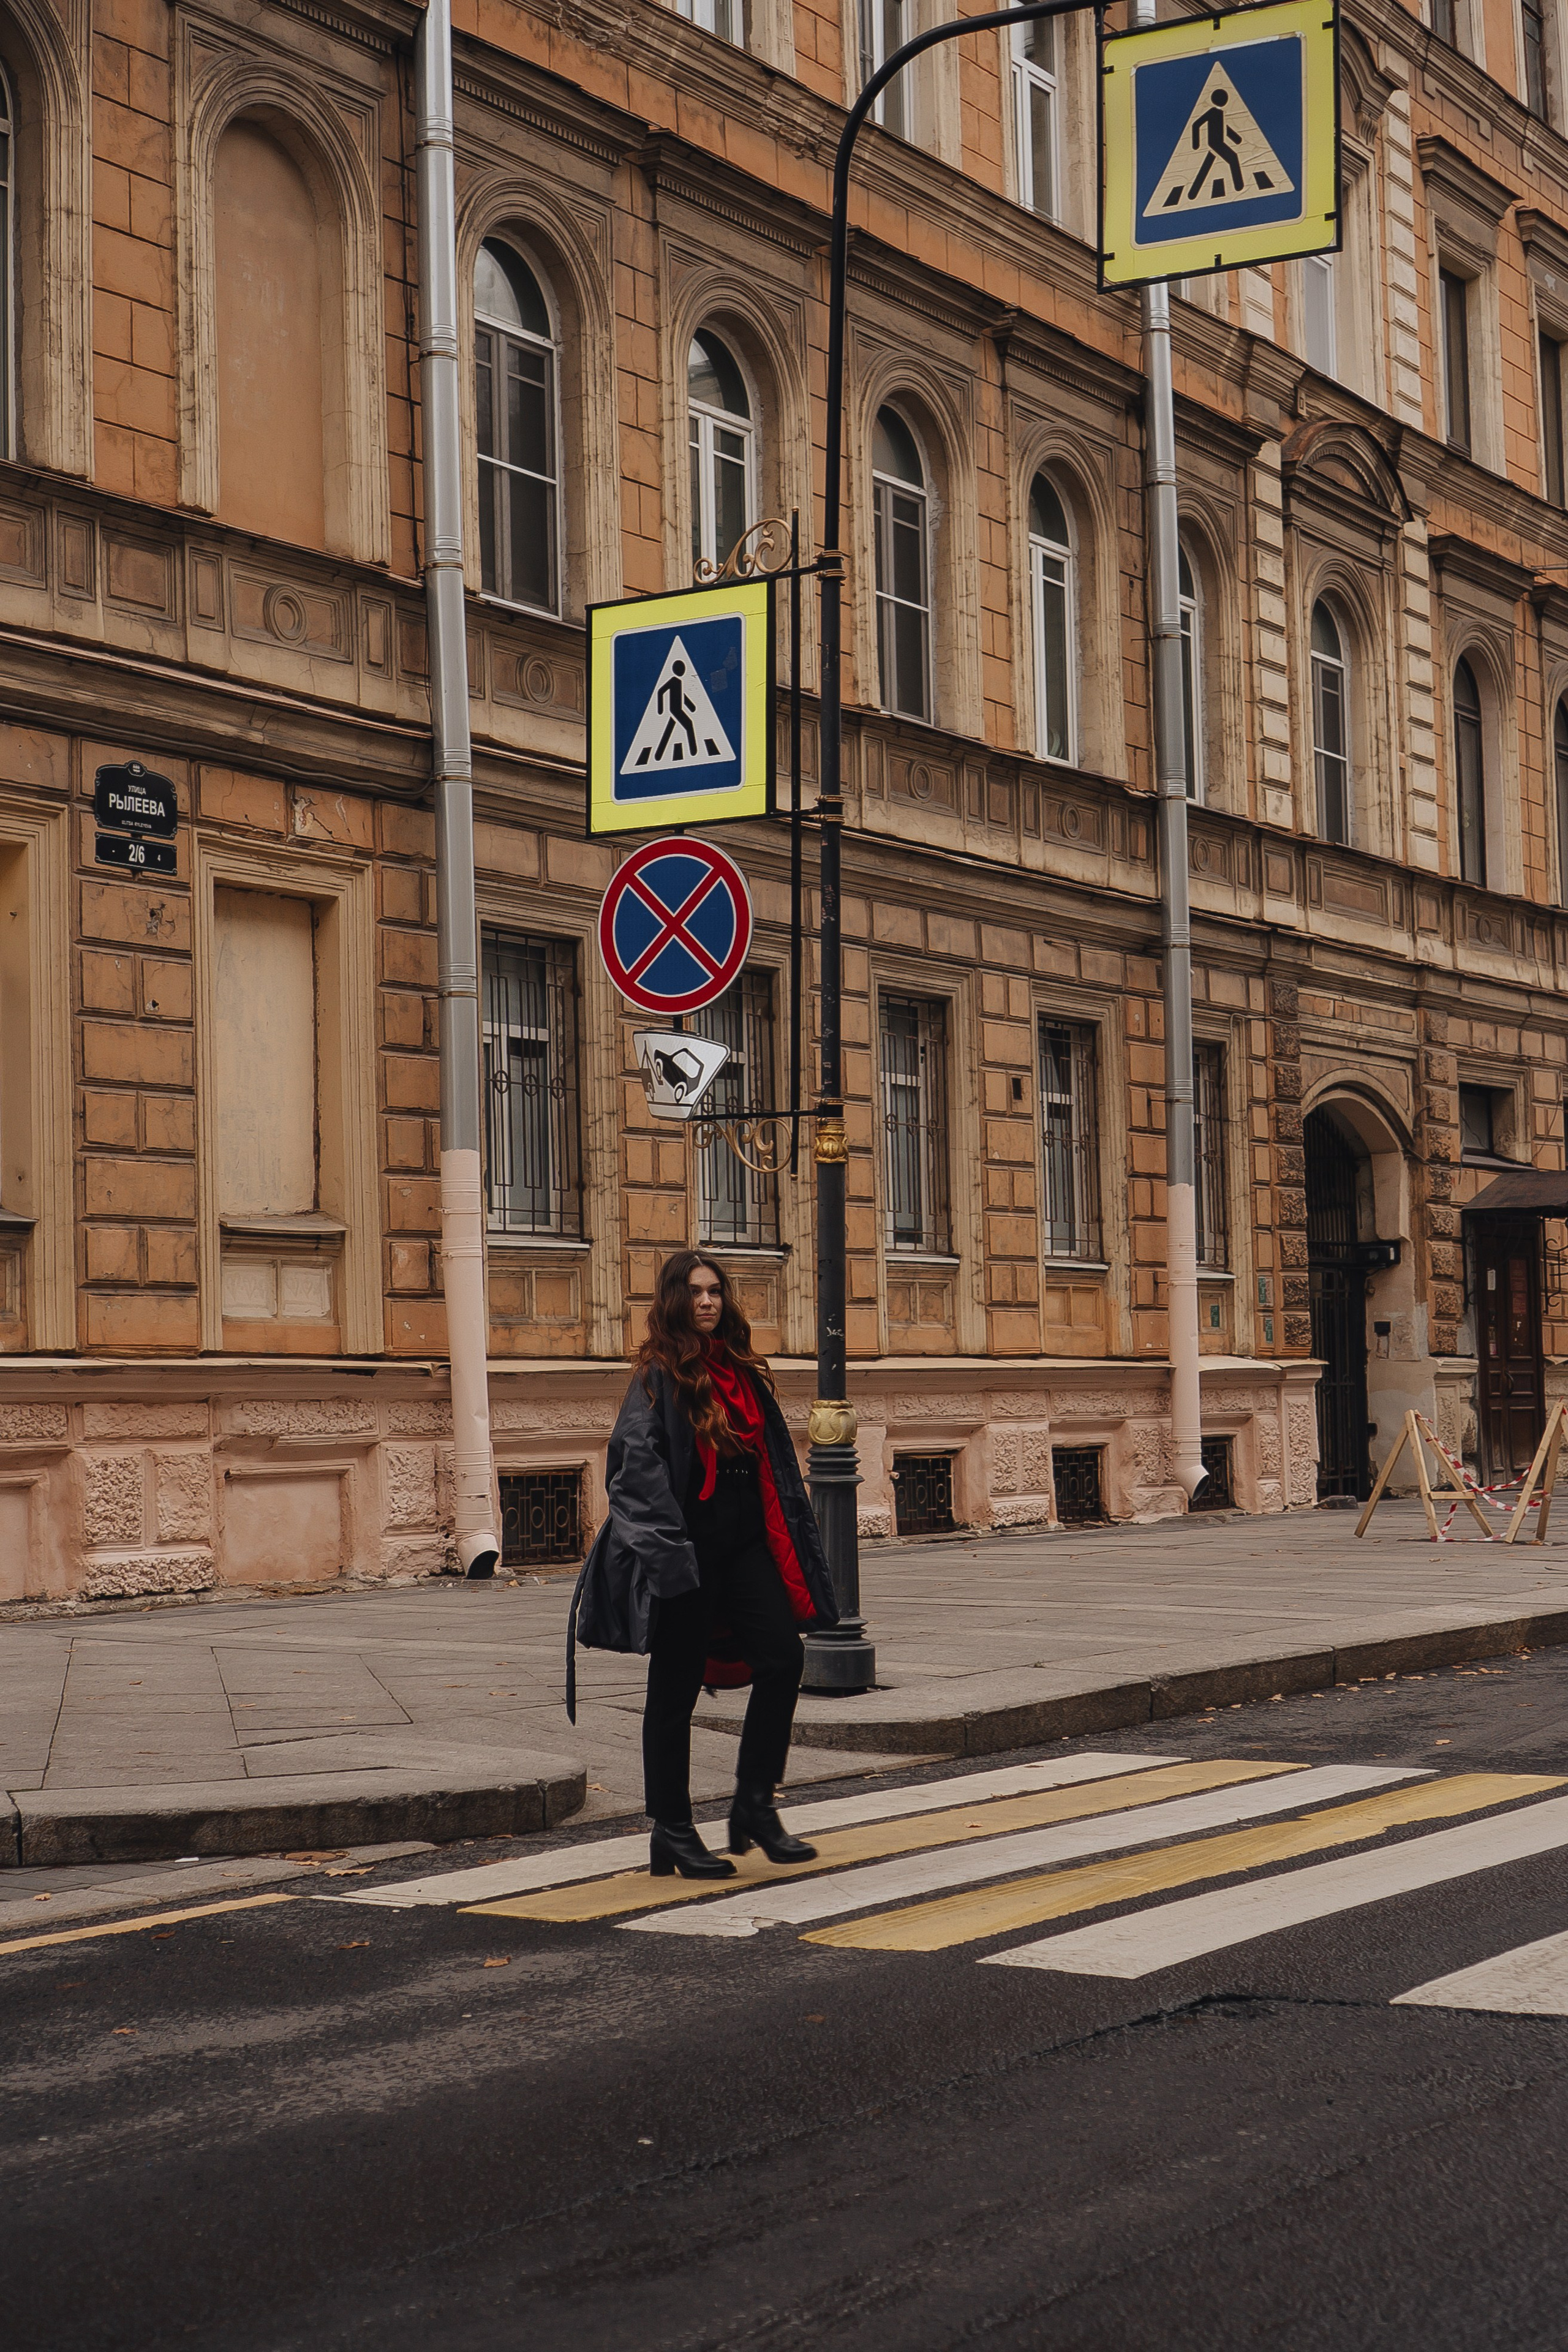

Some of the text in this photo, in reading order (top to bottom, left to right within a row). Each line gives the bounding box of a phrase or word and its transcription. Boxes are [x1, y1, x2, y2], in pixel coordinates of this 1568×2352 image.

[127, 785, 146, 795] УЛИЦА
[109, 793, 165, 817] РЫЛЕЕВА
[129, 844, 145, 864] 2/6
